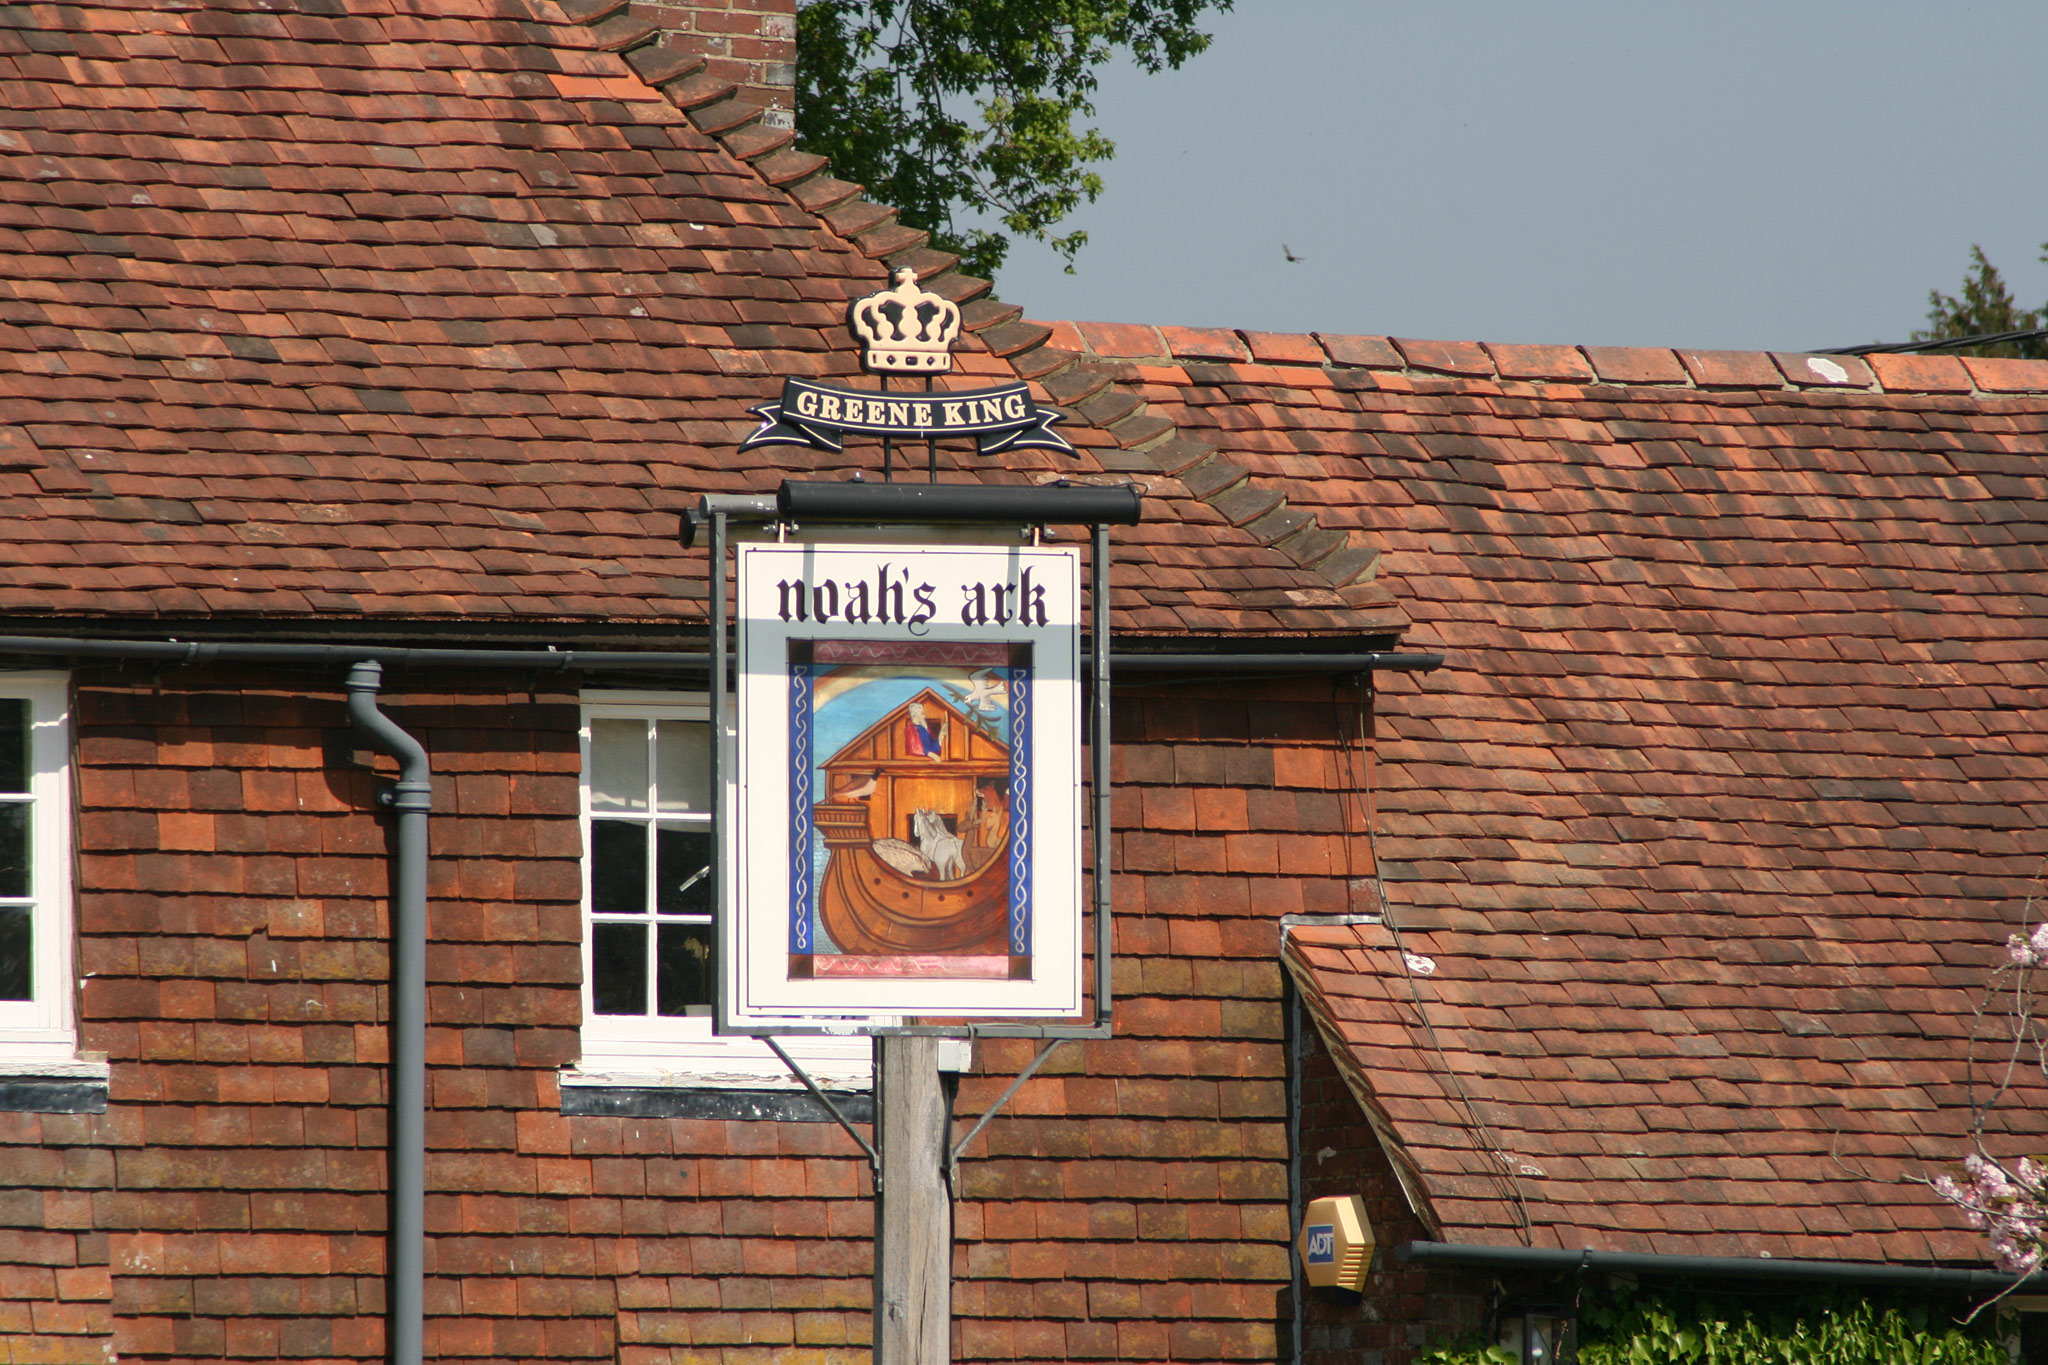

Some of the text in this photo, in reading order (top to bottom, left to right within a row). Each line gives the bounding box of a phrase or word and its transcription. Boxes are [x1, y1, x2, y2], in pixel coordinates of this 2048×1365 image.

[797, 391, 1027, 427] GREENE KING
[776, 563, 1051, 636] noah's ark
[1308, 1233, 1334, 1256] ADT
